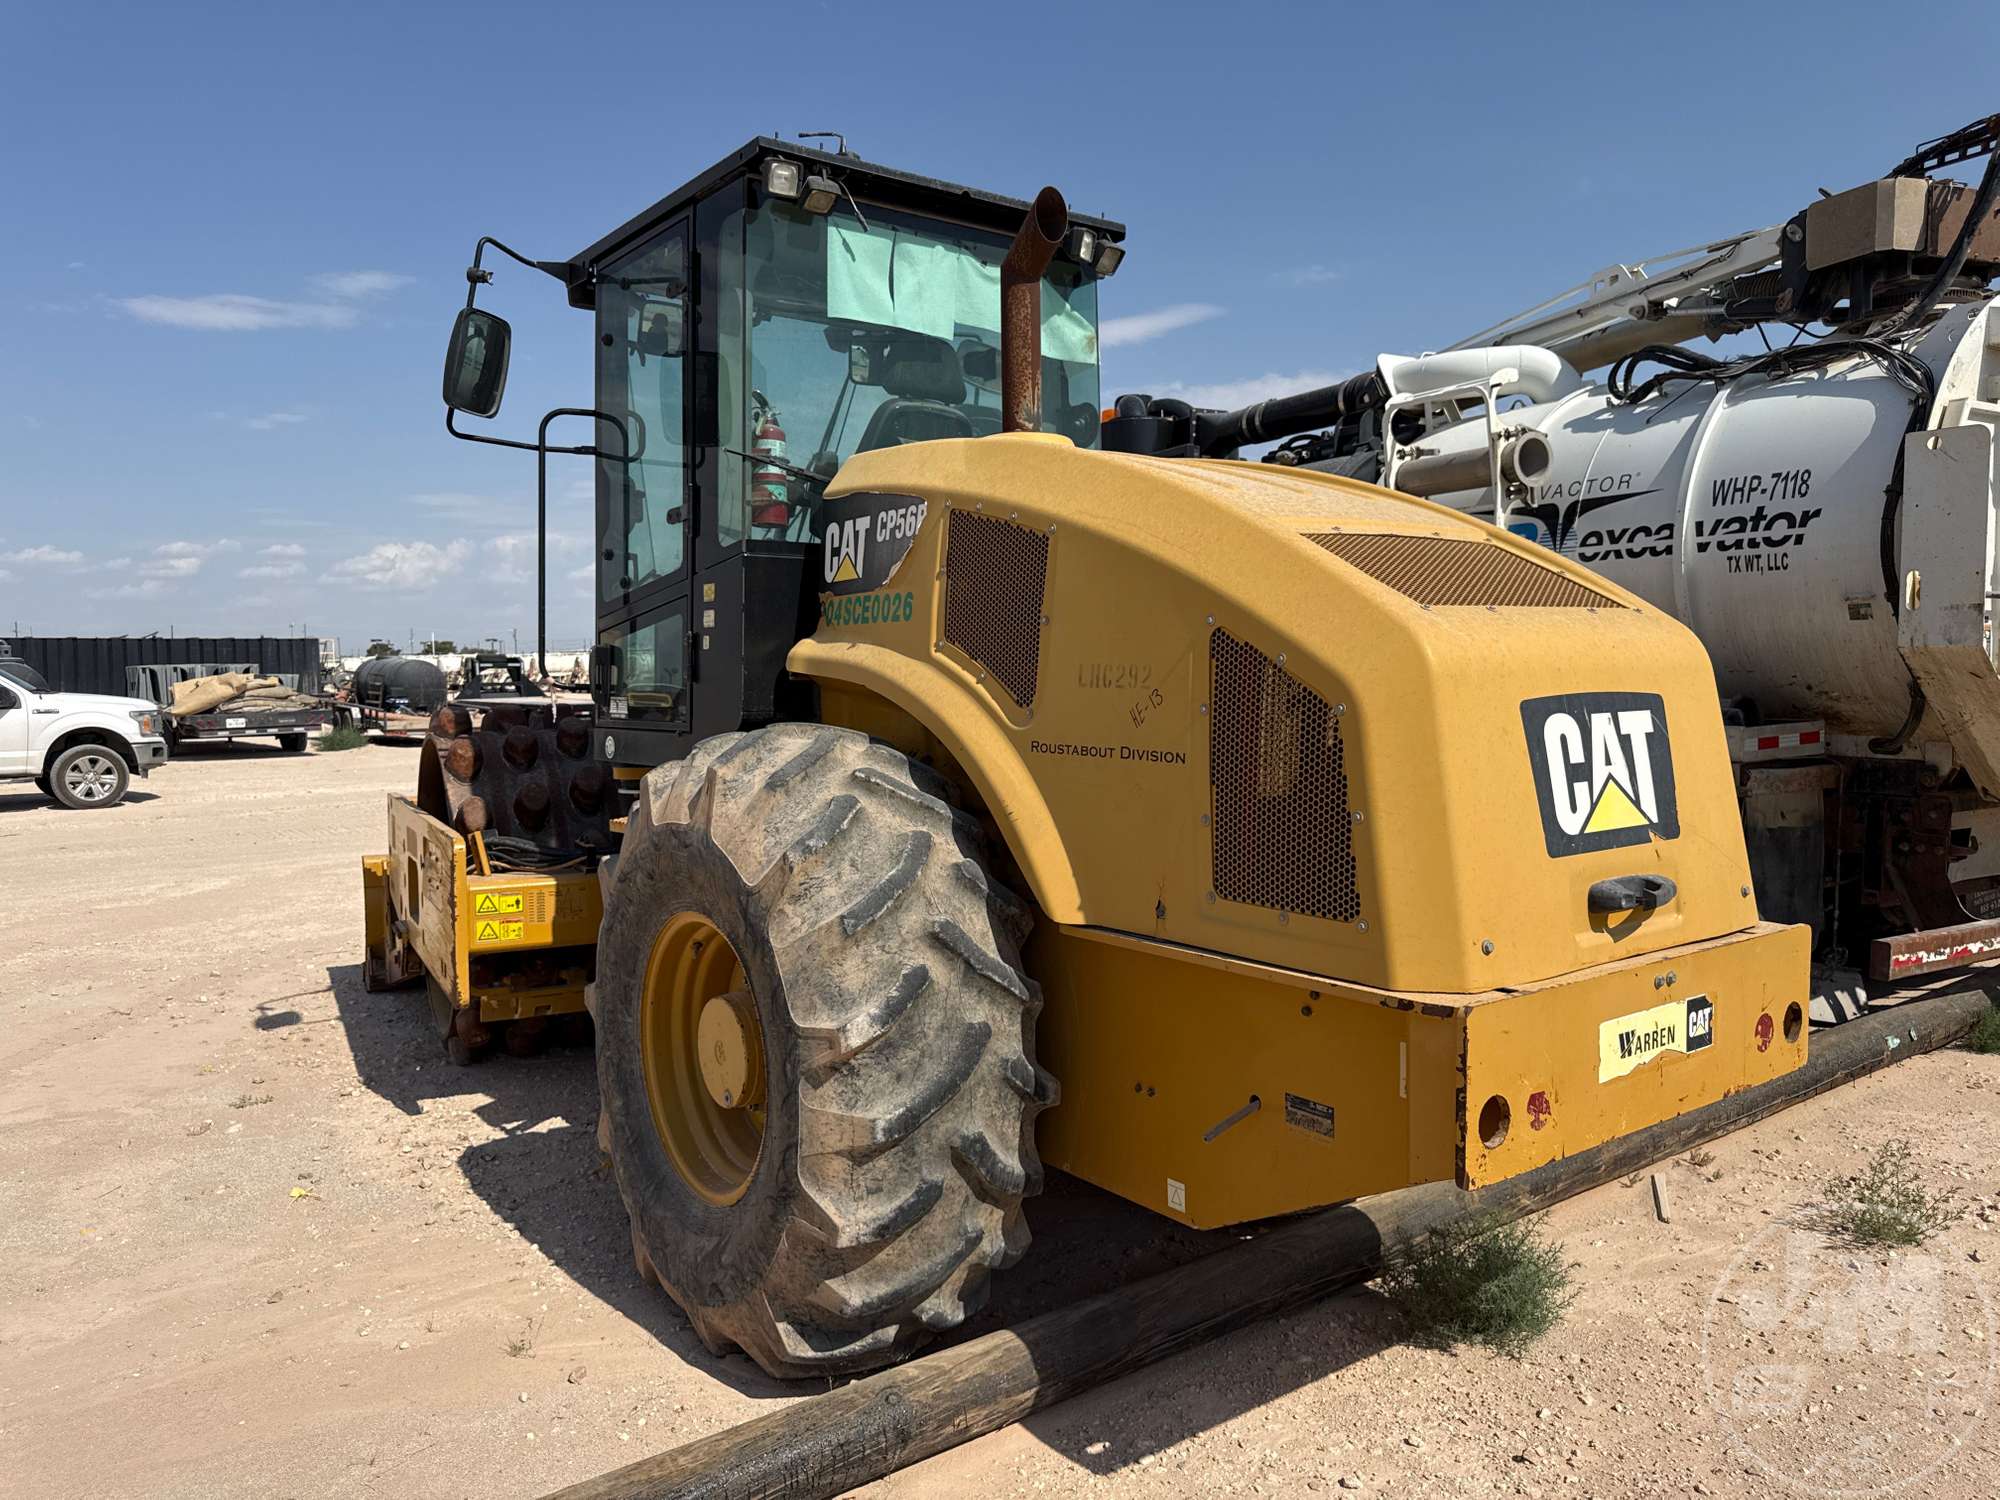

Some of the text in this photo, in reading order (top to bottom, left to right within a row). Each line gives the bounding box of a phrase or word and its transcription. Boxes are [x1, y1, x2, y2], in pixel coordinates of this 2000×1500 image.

[1540, 474, 1632, 500] VACTOR
[1712, 469, 1811, 507] WHP-7118
[825, 516, 871, 583] CAT
[1727, 552, 1789, 575] TX WT, LLC
[1544, 710, 1660, 836] CAT
[1688, 1007, 1712, 1038] CAT
